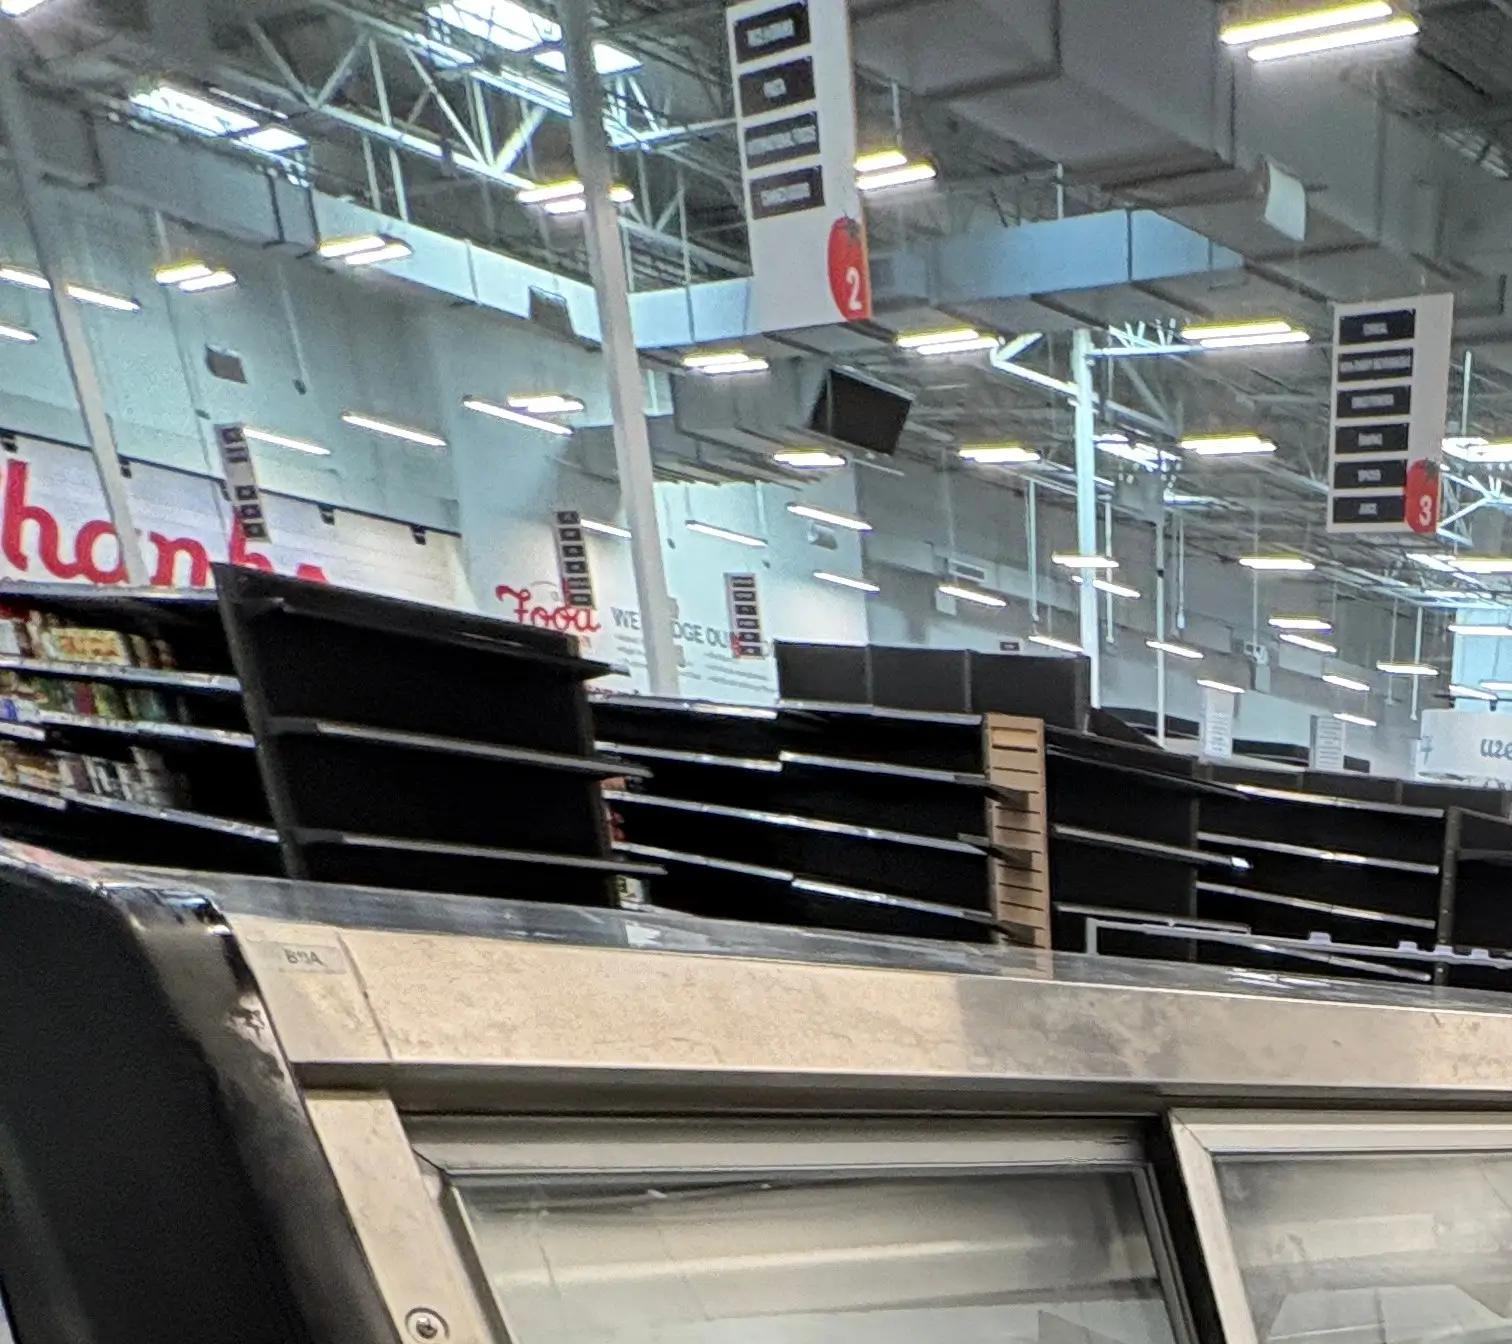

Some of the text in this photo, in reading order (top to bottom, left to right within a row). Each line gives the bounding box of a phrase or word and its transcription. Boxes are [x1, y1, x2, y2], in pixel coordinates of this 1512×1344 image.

[845, 267, 863, 312] 2
[1418, 494, 1432, 527] 3
[610, 606, 642, 630] WE
